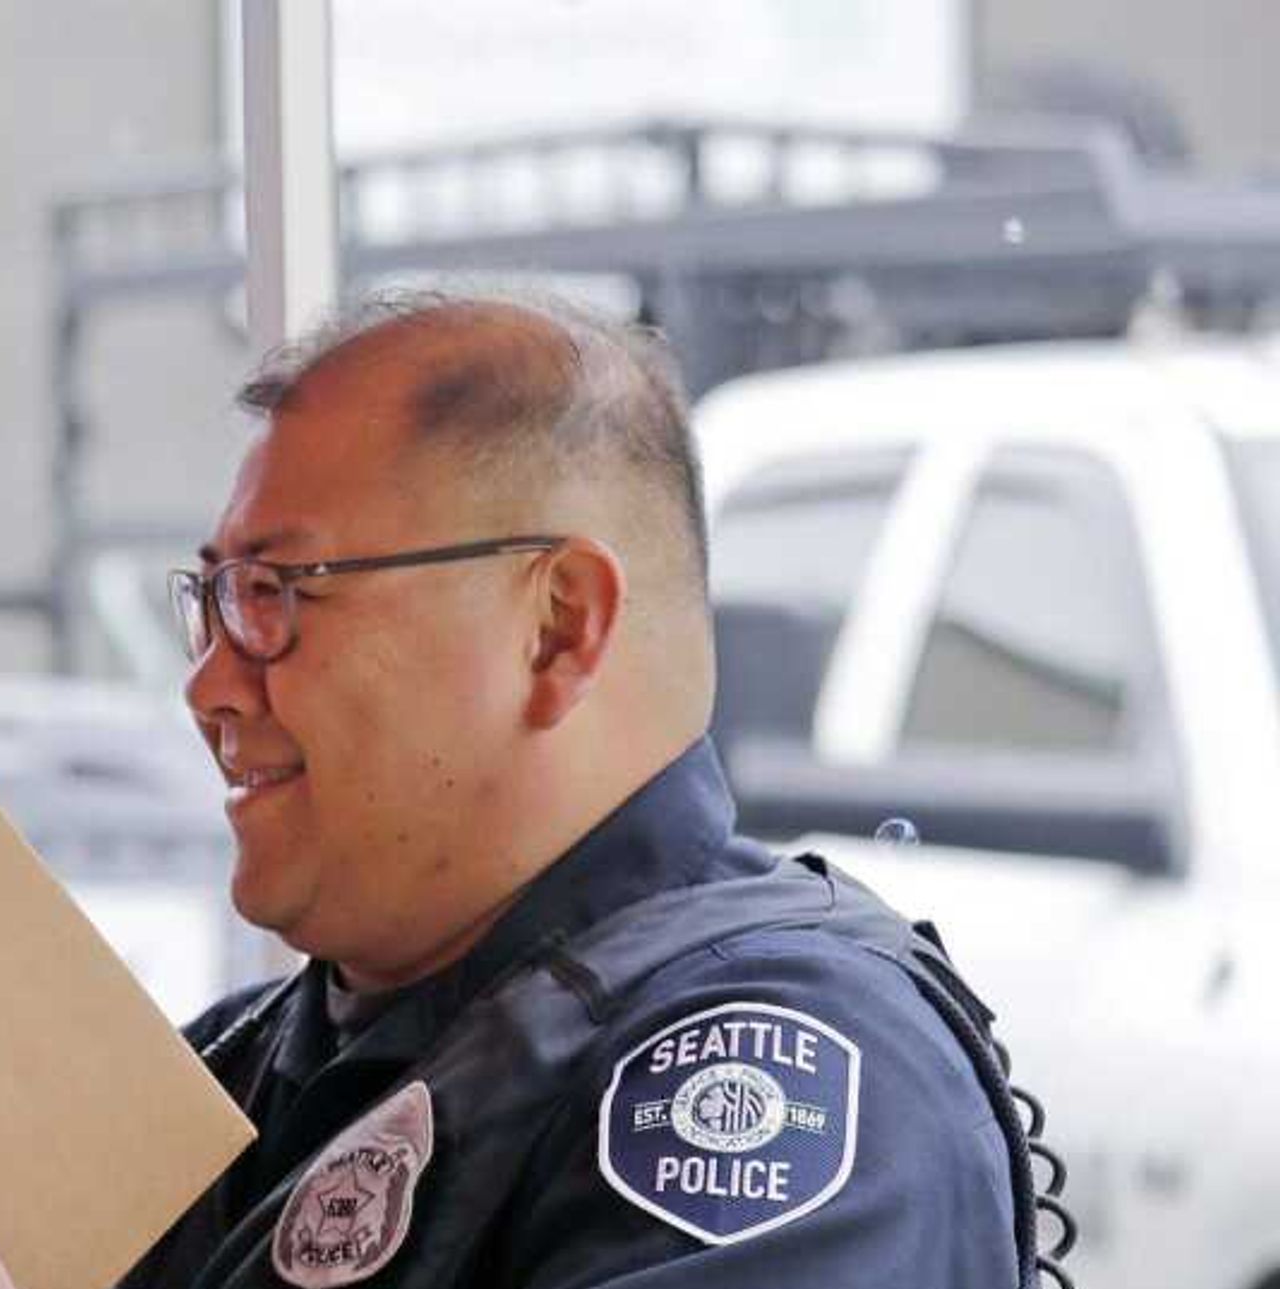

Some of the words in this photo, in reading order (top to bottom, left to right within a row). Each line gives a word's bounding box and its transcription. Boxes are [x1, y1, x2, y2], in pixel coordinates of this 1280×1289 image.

[649, 1022, 818, 1074] SEATTLE
[634, 1105, 667, 1126] EST.
[790, 1107, 826, 1129] 1869
[655, 1157, 791, 1202] POLICE
